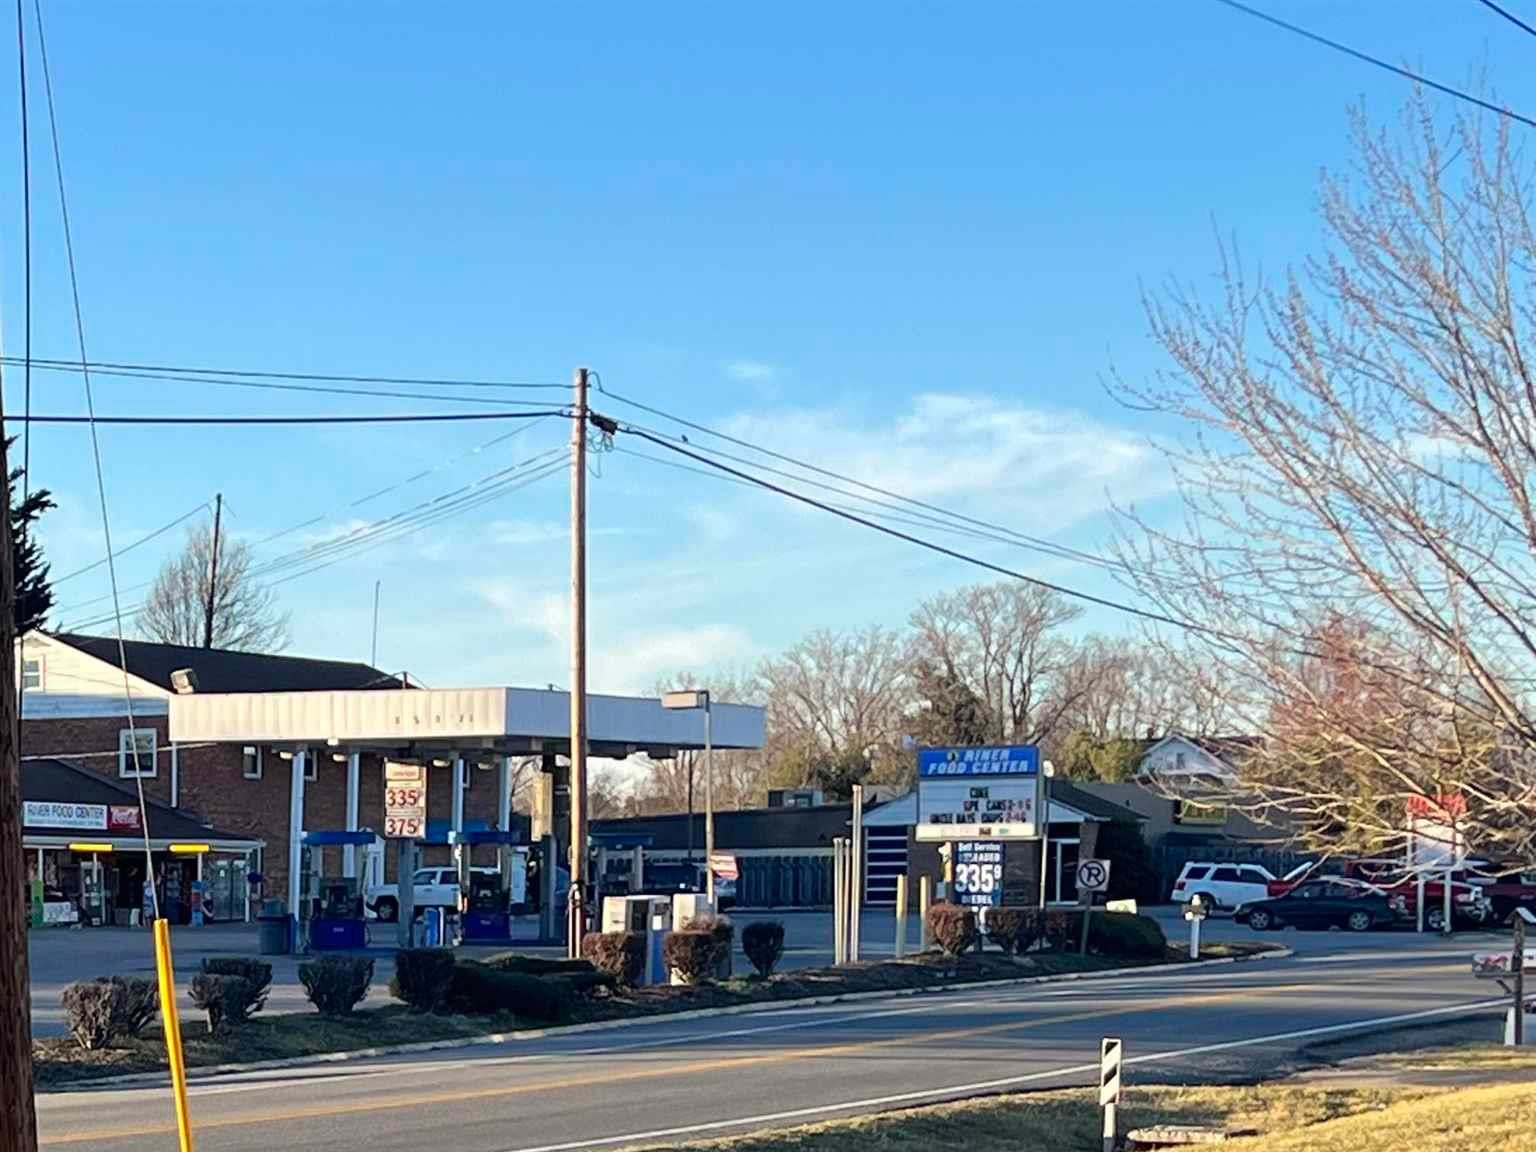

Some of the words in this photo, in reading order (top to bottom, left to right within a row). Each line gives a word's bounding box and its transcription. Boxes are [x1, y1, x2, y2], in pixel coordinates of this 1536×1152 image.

[927, 762, 967, 775] FOOD
[972, 760, 1028, 774] CENTER
[388, 790, 417, 806] 335
[52, 804, 74, 818] FOOD
[75, 806, 105, 819] CENTER
[388, 818, 417, 836] 375
